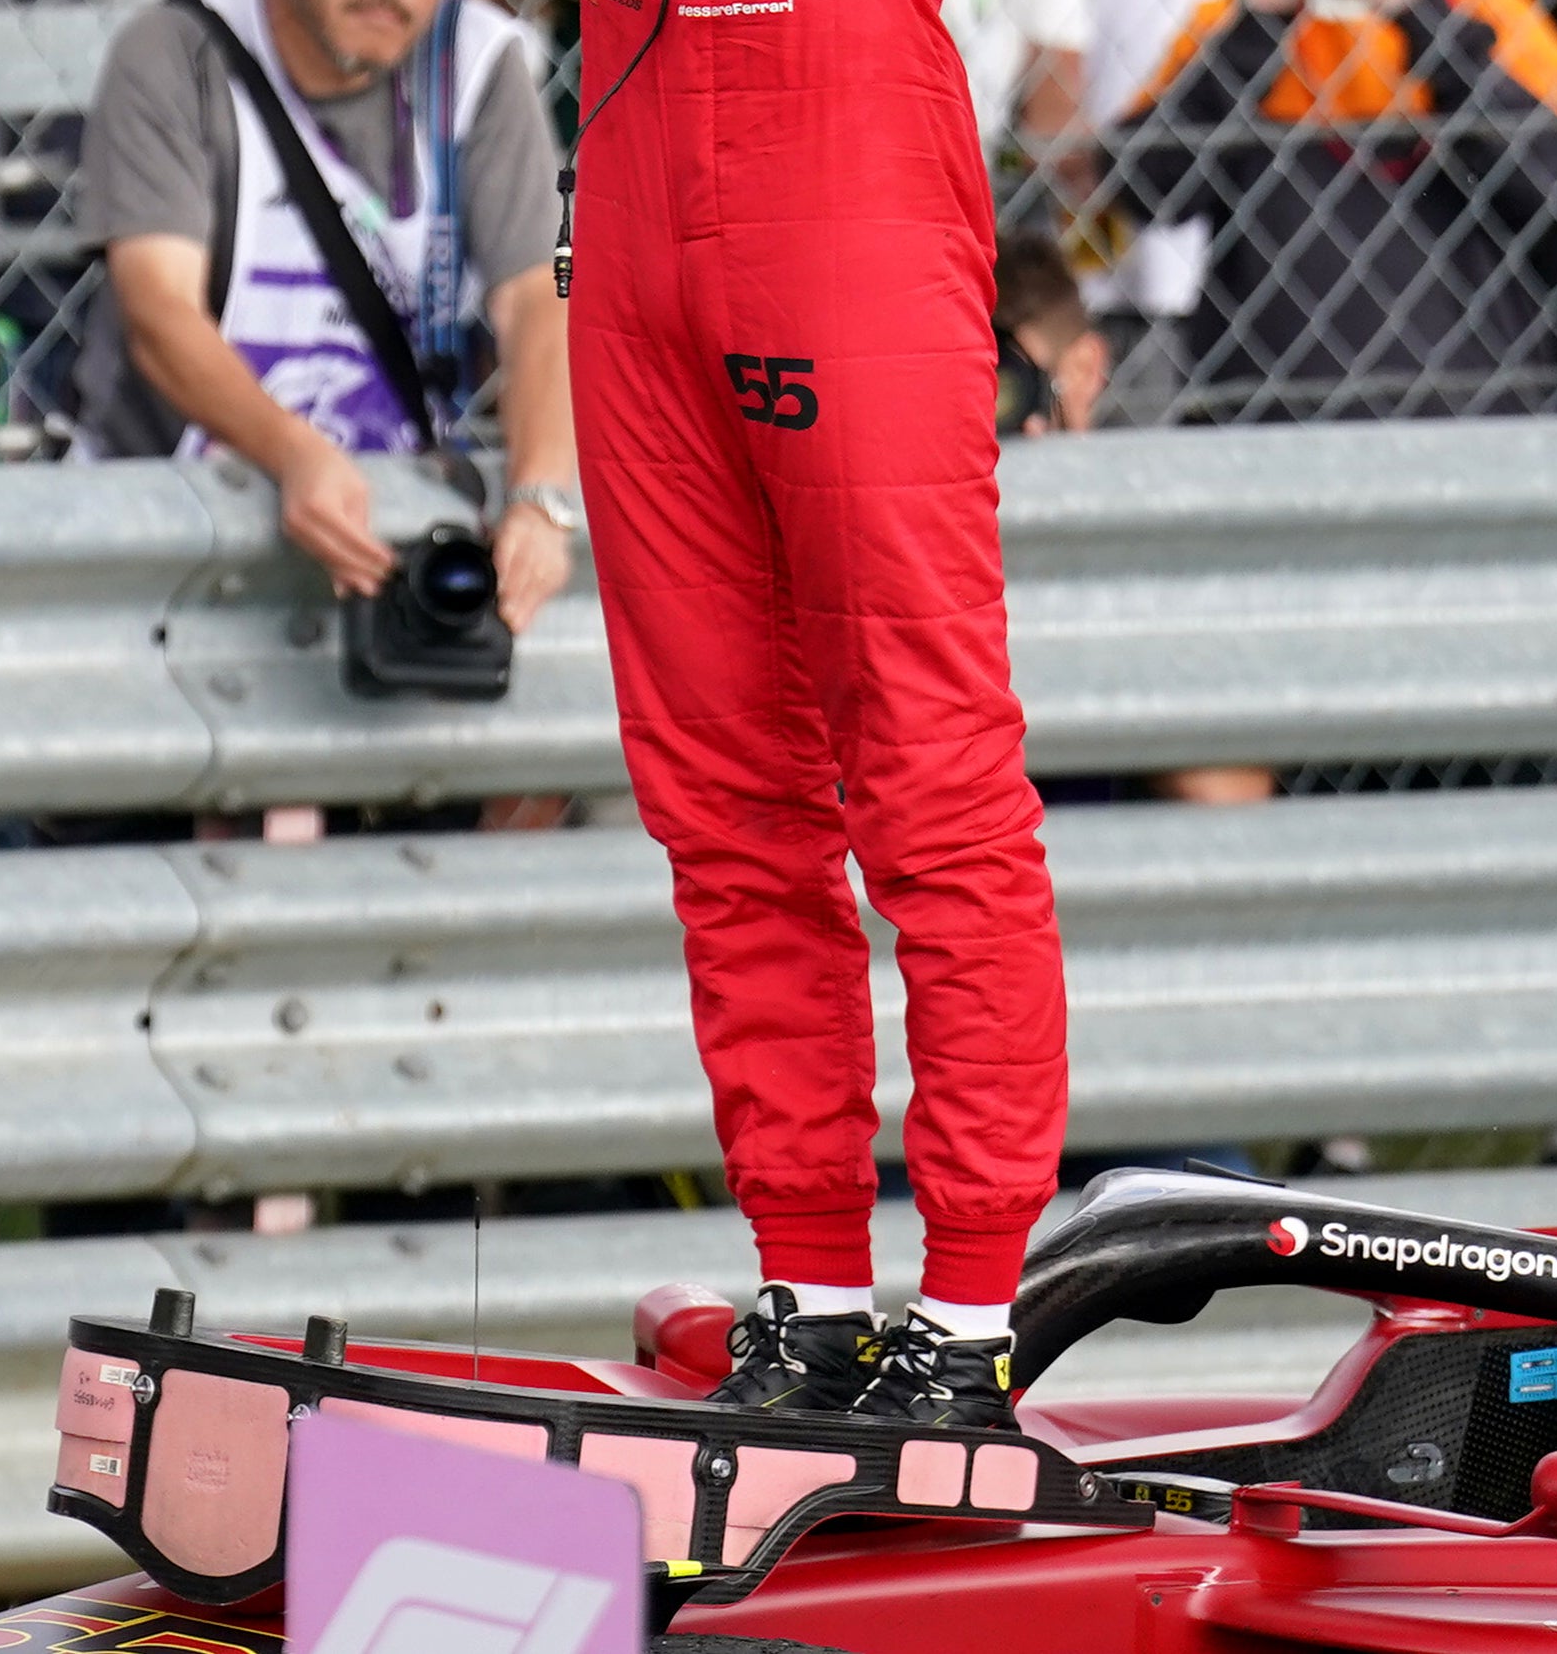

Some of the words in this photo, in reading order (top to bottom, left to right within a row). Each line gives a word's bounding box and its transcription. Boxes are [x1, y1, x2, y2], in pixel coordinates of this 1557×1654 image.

[678, 0, 793, 18] #essereFerrari
[724, 353, 819, 431] 55
[1164, 1488, 1193, 1513] 55
